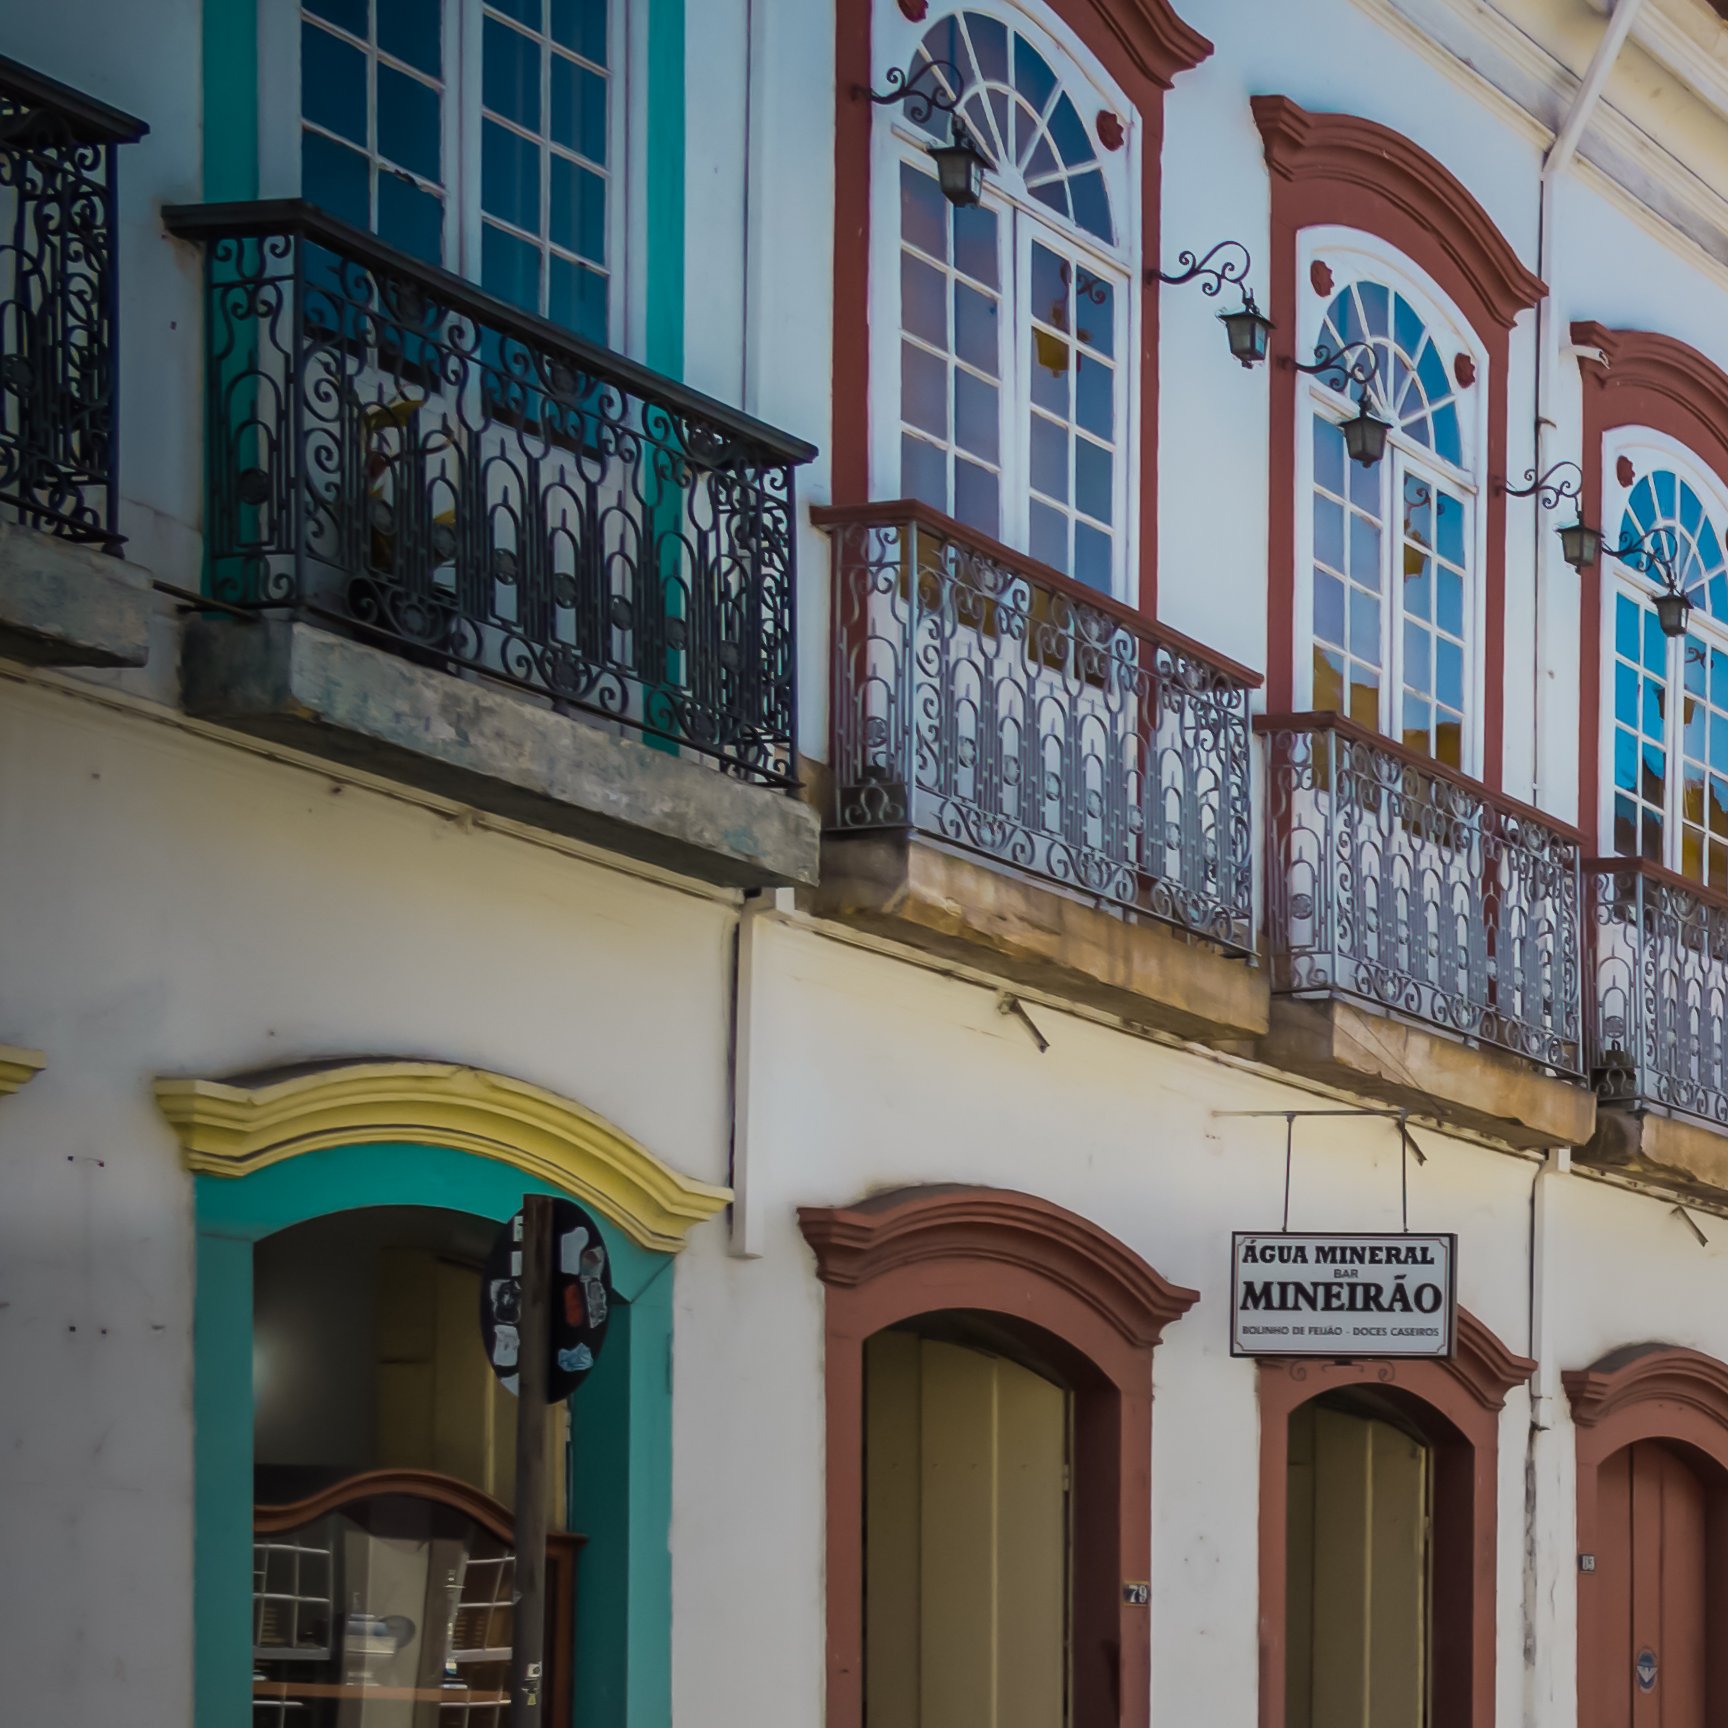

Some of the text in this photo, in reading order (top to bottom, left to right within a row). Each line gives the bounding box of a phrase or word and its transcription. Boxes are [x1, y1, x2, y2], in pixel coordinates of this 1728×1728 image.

[1241, 1239, 1435, 1265] ÁGUA MINERAL
[1333, 1268, 1359, 1279] BAR
[1239, 1273, 1443, 1314] MINEIRÃO
[1241, 1325, 1290, 1336] BOLINHO
[1292, 1326, 1305, 1336] DE
[1352, 1327, 1388, 1337] DOCES
[1390, 1327, 1440, 1338] CASEIROS
